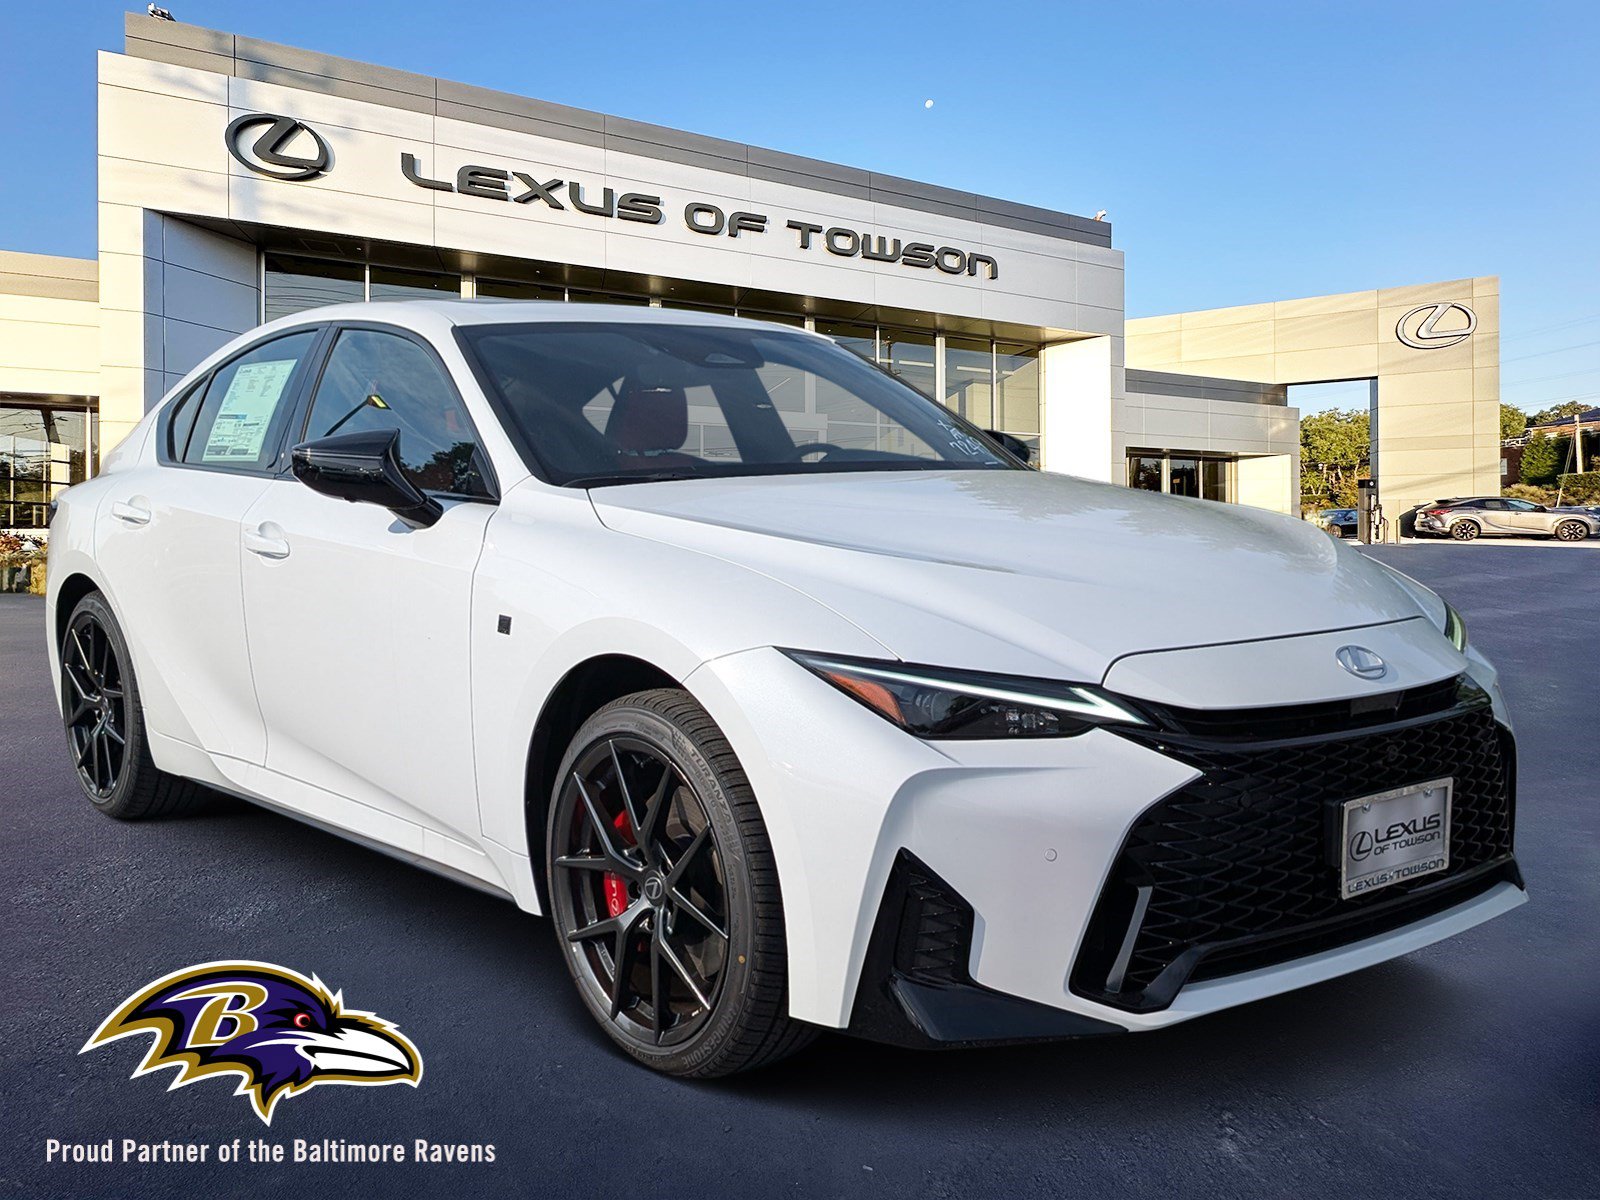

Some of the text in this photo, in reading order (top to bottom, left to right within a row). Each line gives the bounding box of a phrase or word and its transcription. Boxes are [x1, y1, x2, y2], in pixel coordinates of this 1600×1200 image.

[401, 153, 998, 280] LEXUS OF TOWSON
[1373, 831, 1441, 856] OF TOWSON
[1375, 813, 1441, 844] LEXUS
[1348, 874, 1388, 893] LEXUS
[1395, 858, 1445, 880] TOWSON
